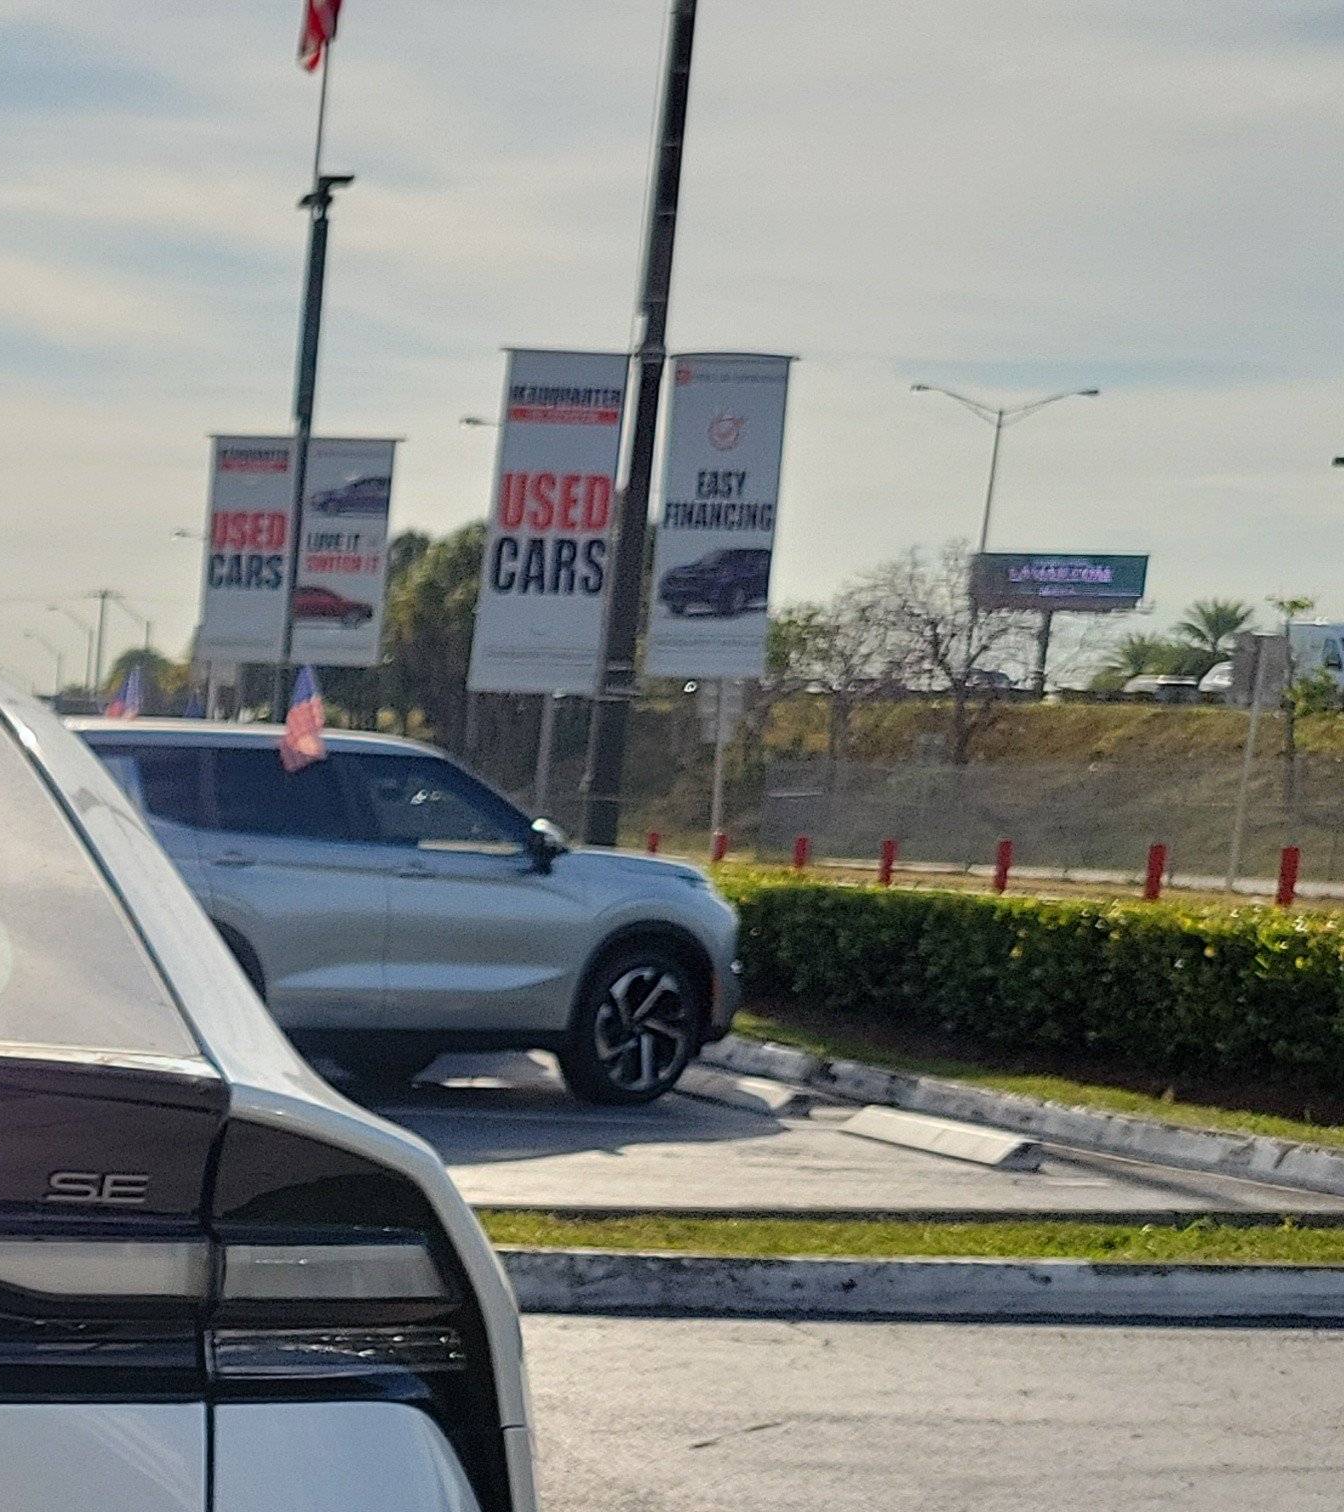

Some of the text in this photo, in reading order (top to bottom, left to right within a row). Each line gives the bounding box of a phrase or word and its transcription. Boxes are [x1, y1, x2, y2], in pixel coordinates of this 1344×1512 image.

[500, 473, 611, 532] USED
[697, 470, 747, 499] EASY
[211, 511, 287, 550] USED
[663, 501, 774, 531] FINANCING
[210, 553, 284, 590] CARS
[492, 536, 606, 594] CARS
[45, 1171, 151, 1204] SE
